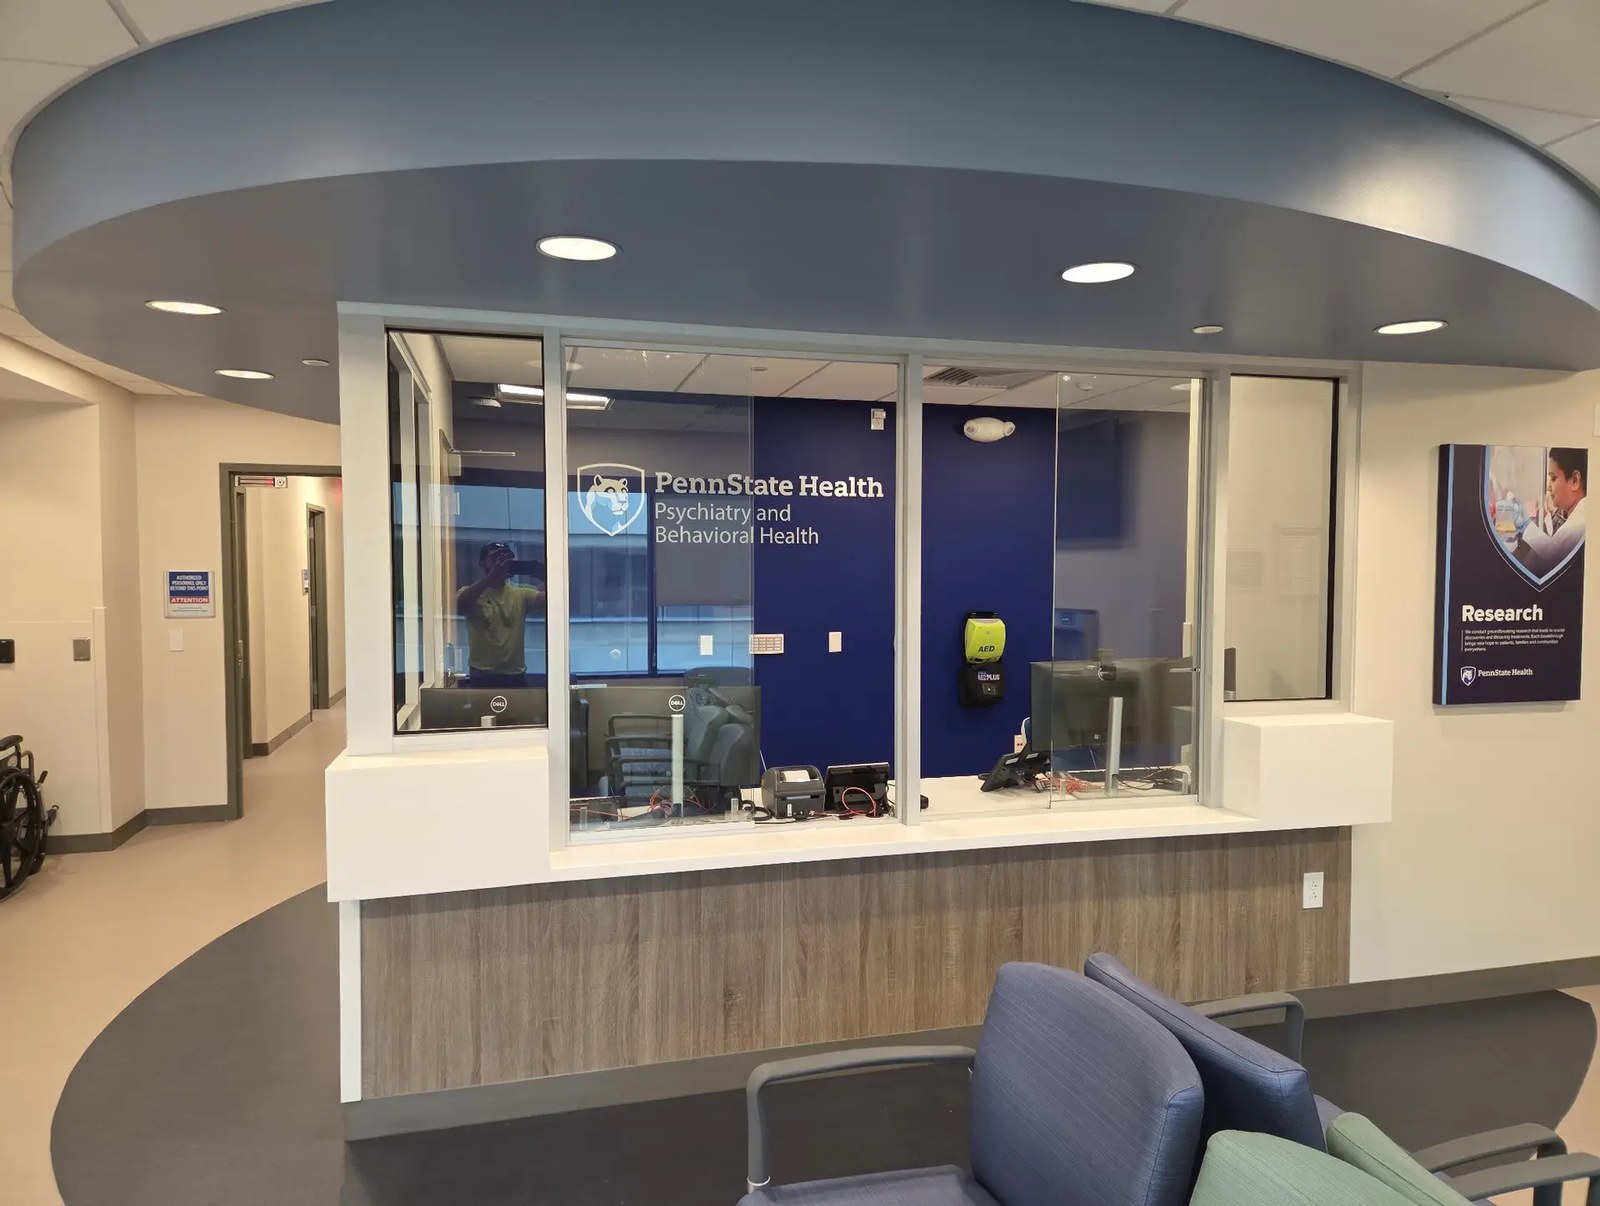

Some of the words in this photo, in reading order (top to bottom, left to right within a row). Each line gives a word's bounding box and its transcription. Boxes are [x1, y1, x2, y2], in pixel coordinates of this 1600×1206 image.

[654, 472, 794, 497] PennState
[798, 475, 884, 498] Health
[655, 502, 752, 525] Psychiatry
[756, 504, 791, 522] and
[655, 525, 754, 544] Behavioral
[760, 526, 819, 545] Health
[1462, 604, 1543, 621] Research
